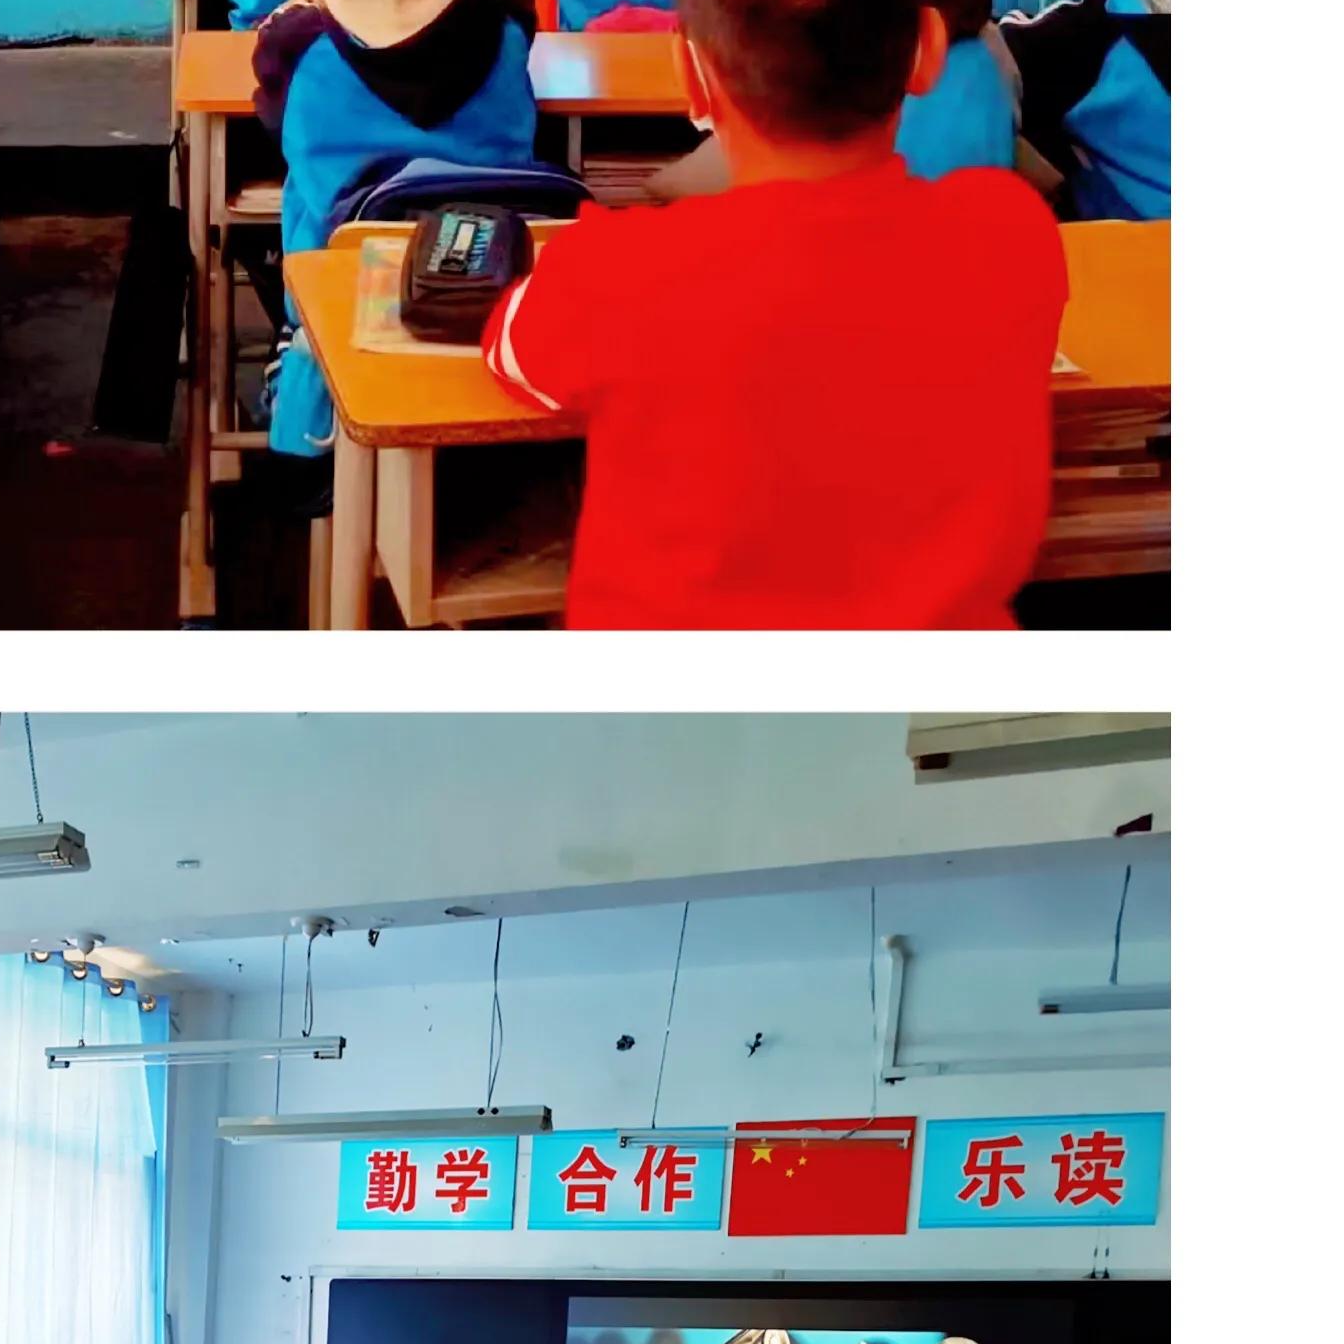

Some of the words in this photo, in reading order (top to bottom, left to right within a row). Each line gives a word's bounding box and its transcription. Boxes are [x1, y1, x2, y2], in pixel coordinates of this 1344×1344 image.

[366, 1148, 489, 1213] 勤学
[559, 1146, 697, 1213] 合作
[958, 1131, 1125, 1207] 乐读
